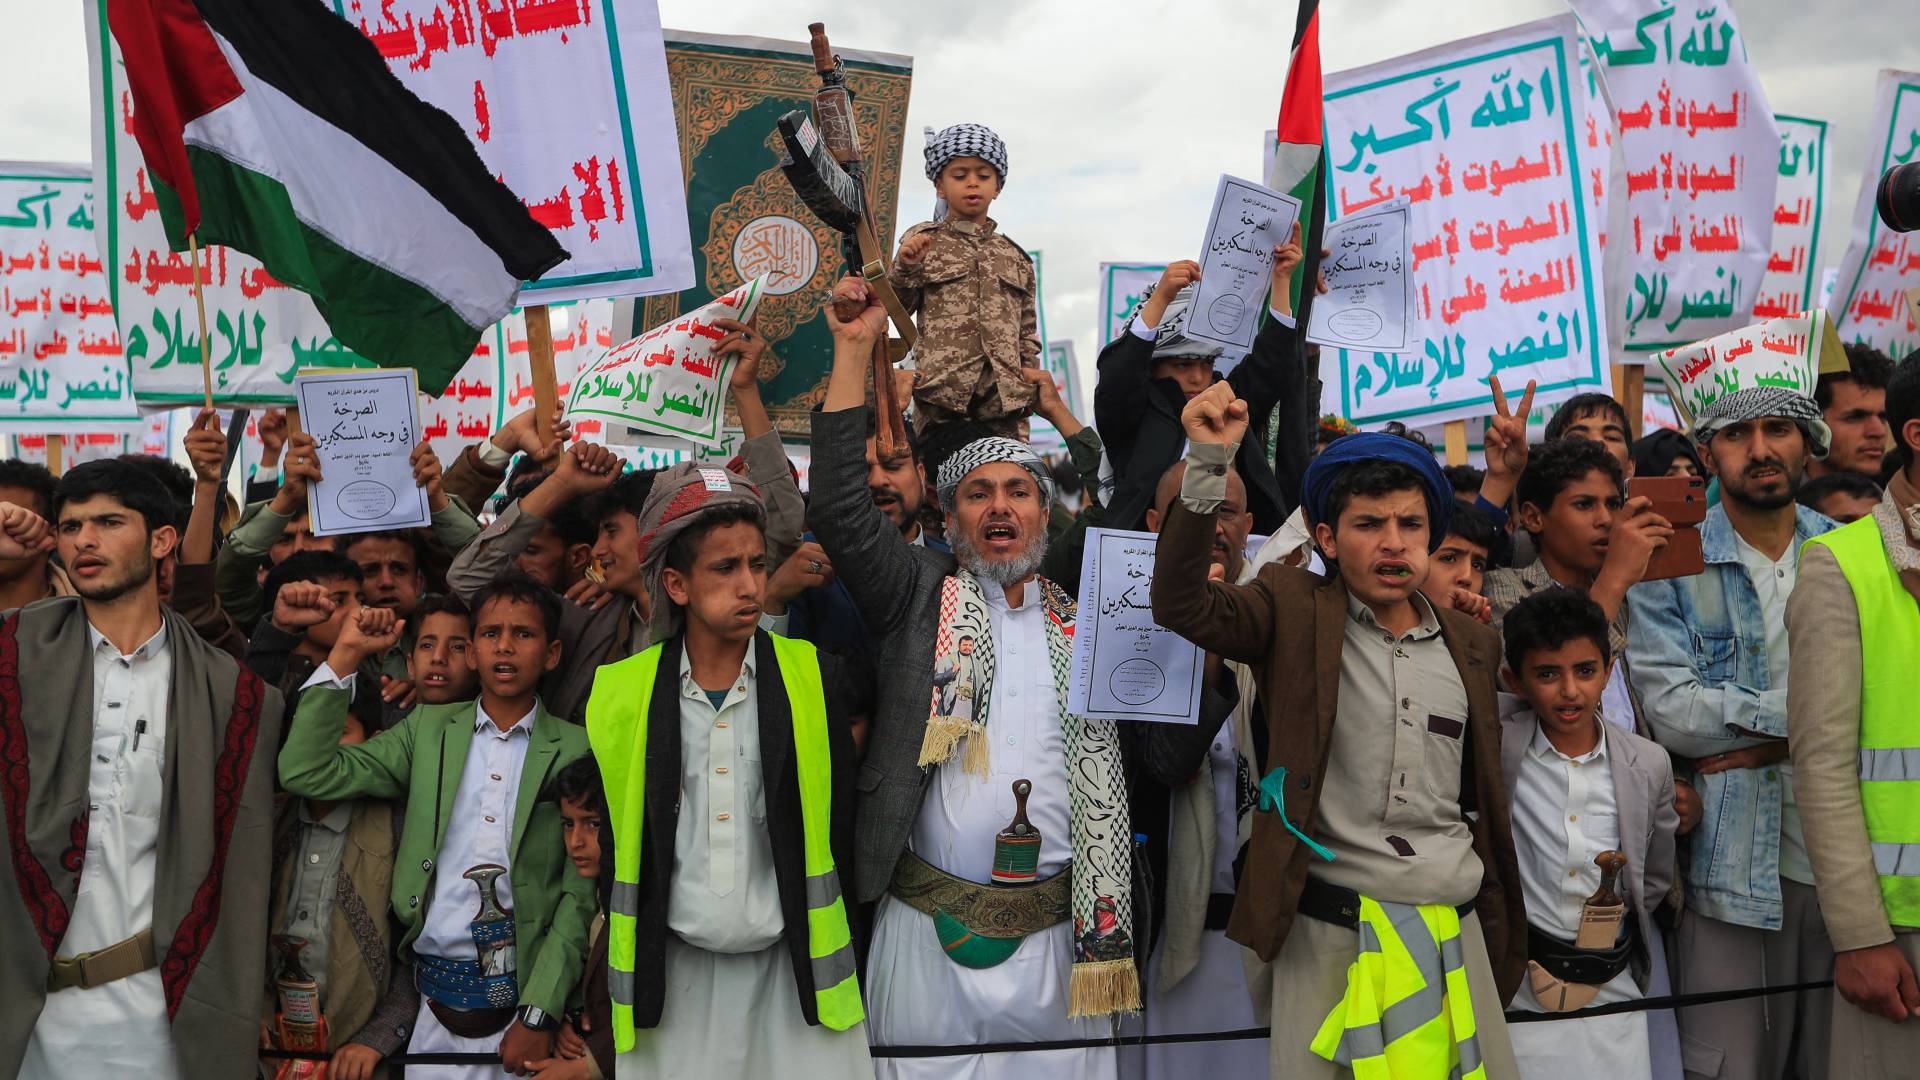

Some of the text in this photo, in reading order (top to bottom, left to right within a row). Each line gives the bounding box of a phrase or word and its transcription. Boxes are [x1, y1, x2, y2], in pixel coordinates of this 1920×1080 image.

[1336, 78, 1460, 175] أكبر
[1462, 141, 1563, 196] الموت
[1469, 200, 1570, 255] الموت
[1773, 197, 1811, 227] الم
[1340, 232, 1377, 252] الصرخة
[1767, 244, 1804, 275] الم
[1368, 259, 1389, 272] وجه
[1391, 250, 1401, 275] في
[1498, 255, 1576, 304] اللعنة
[59, 293, 113, 321] موت
[1441, 276, 1486, 325] على
[1665, 265, 1742, 333] النصر
[1752, 291, 1798, 318] اللعن
[34, 329, 68, 361] على
[127, 306, 267, 389] للإسلام
[643, 343, 674, 367] على
[1353, 309, 1582, 408] النصر للإسلام
[1678, 330, 1806, 384] اللعنة على اليهود
[681, 346, 723, 381] اللعنة
[1754, 360, 1807, 391] النصر
[0, 365, 132, 413] النصر للإس
[576, 371, 653, 410] للإسلام
[653, 382, 714, 419] النصر
[333, 400, 378, 421] الصرخة
[315, 421, 409, 450] في وجه المستكبرين
